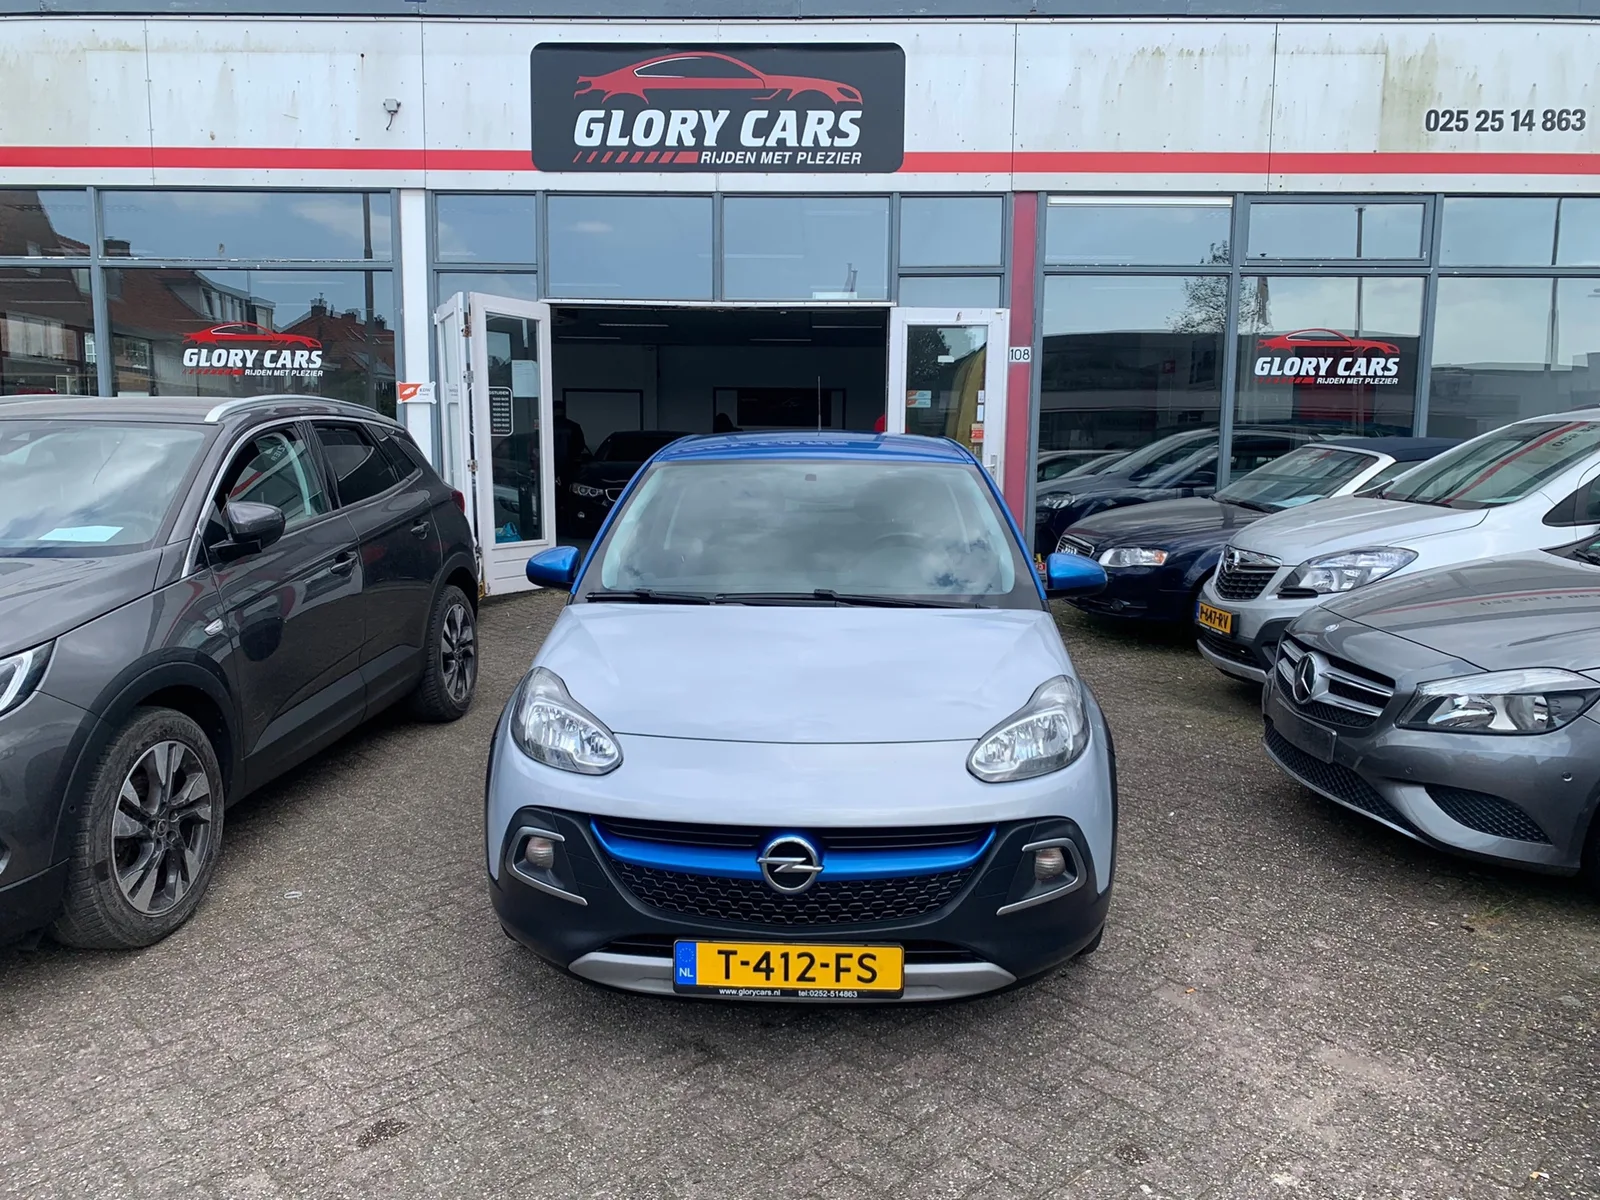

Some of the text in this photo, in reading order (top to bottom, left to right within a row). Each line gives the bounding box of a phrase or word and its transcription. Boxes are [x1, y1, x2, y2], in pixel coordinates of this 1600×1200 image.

[573, 109, 863, 147] GLORY CARS
[1425, 108, 1586, 132] 025 25 14 863
[700, 151, 862, 165] RIJDEN MET PLEZIER
[183, 348, 323, 368] GLORY CARS
[1010, 349, 1030, 360] 108
[1254, 357, 1400, 376] GLORY CARS
[1364, 377, 1398, 385] PLEZIER
[679, 949, 878, 984] NL T-412-FS
[719, 988, 858, 998] www.glorycars.nl tel:0252-514863
